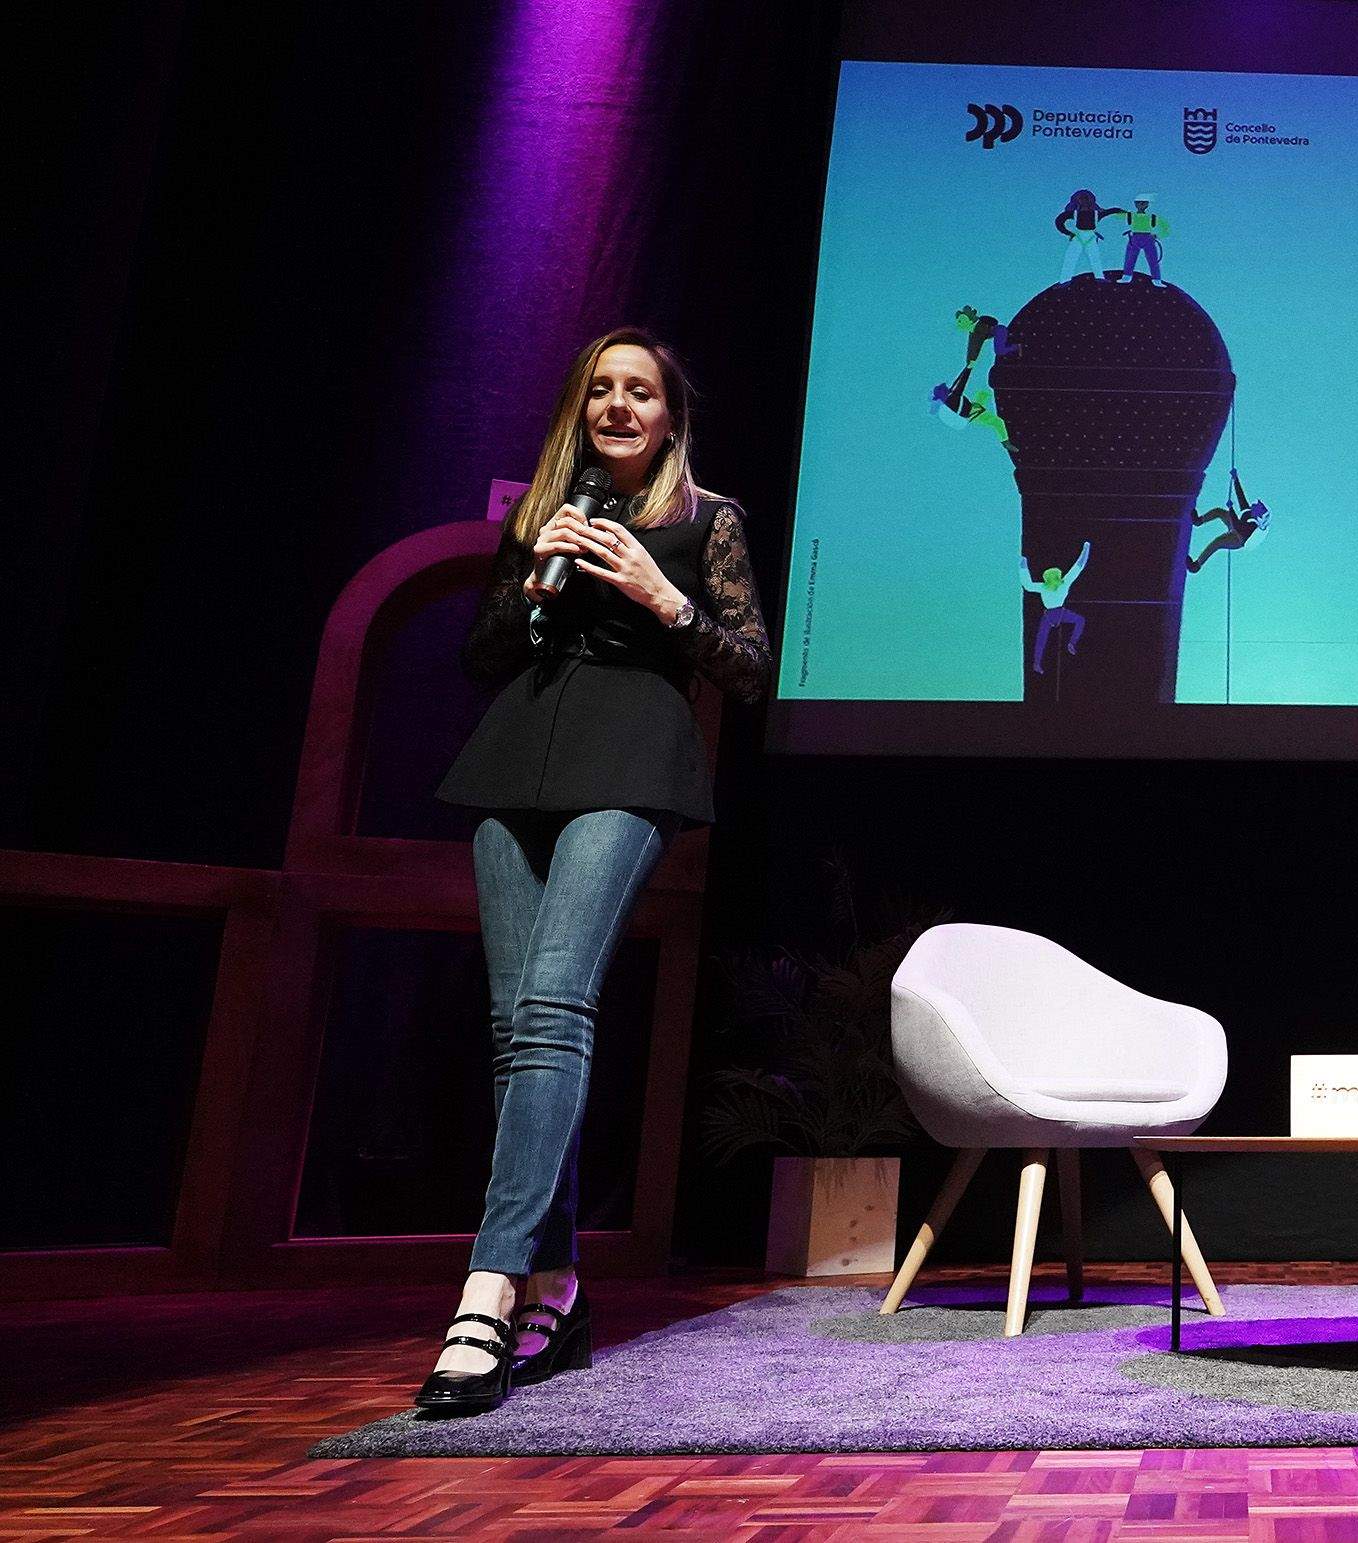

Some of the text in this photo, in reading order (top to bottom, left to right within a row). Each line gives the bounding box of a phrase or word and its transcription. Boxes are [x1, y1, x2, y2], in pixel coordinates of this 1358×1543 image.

[1032, 108, 1134, 125] Deputación
[1031, 123, 1133, 139] Pontevedra
[1225, 122, 1276, 133] Concello
[1225, 134, 1310, 146] de Pontevedra
